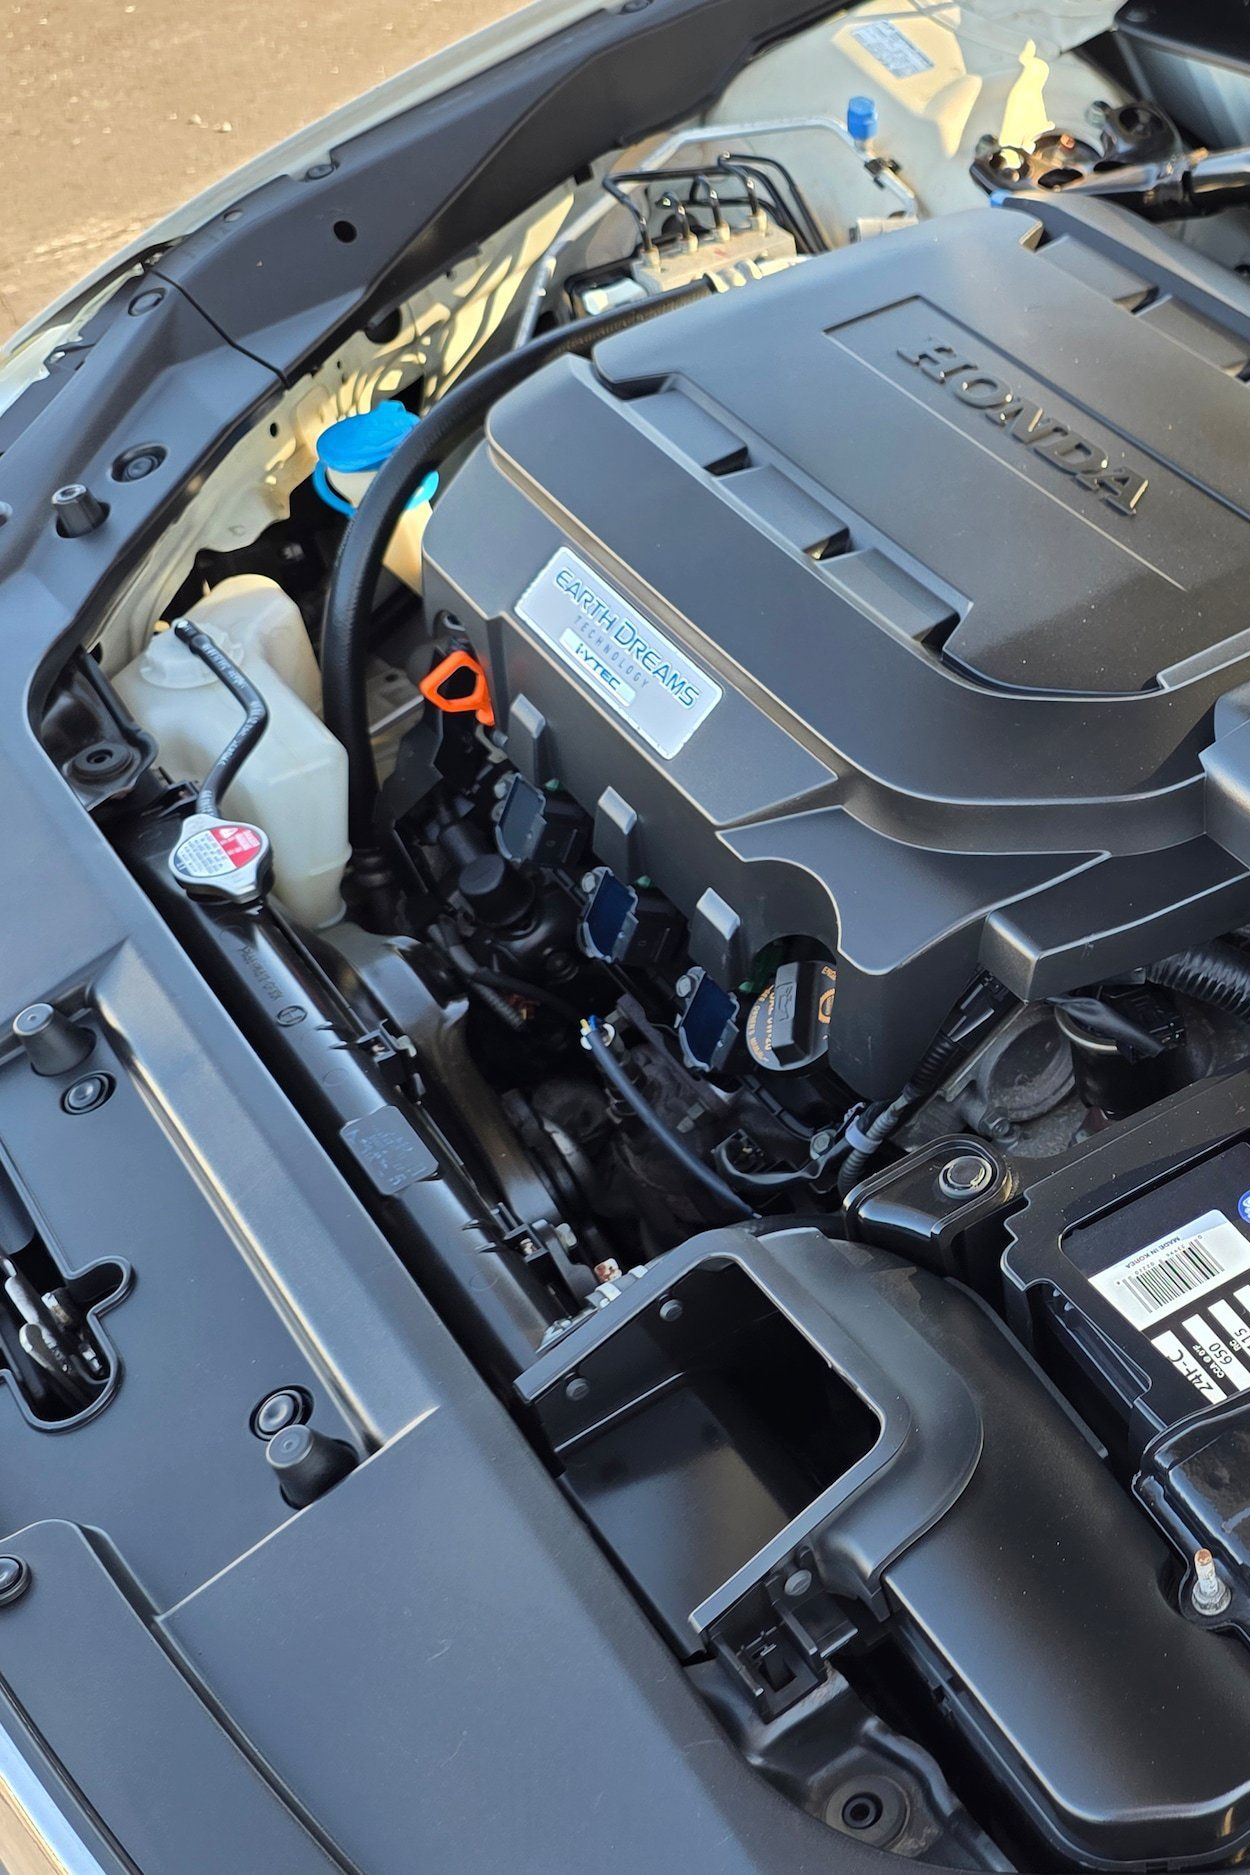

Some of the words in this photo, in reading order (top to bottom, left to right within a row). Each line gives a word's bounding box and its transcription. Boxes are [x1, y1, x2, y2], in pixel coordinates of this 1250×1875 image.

[897, 336, 1149, 515] HONDA
[556, 570, 615, 630] EARTH
[614, 622, 697, 705] DREAMS
[574, 615, 647, 686] TECHNOLOGY
[1158, 1236, 1180, 1249] MADE
[1125, 1252, 1150, 1268] KOREA
[1208, 1342, 1232, 1364] 650
[1229, 1338, 1241, 1351] RC
[1209, 1360, 1224, 1378] CCA
